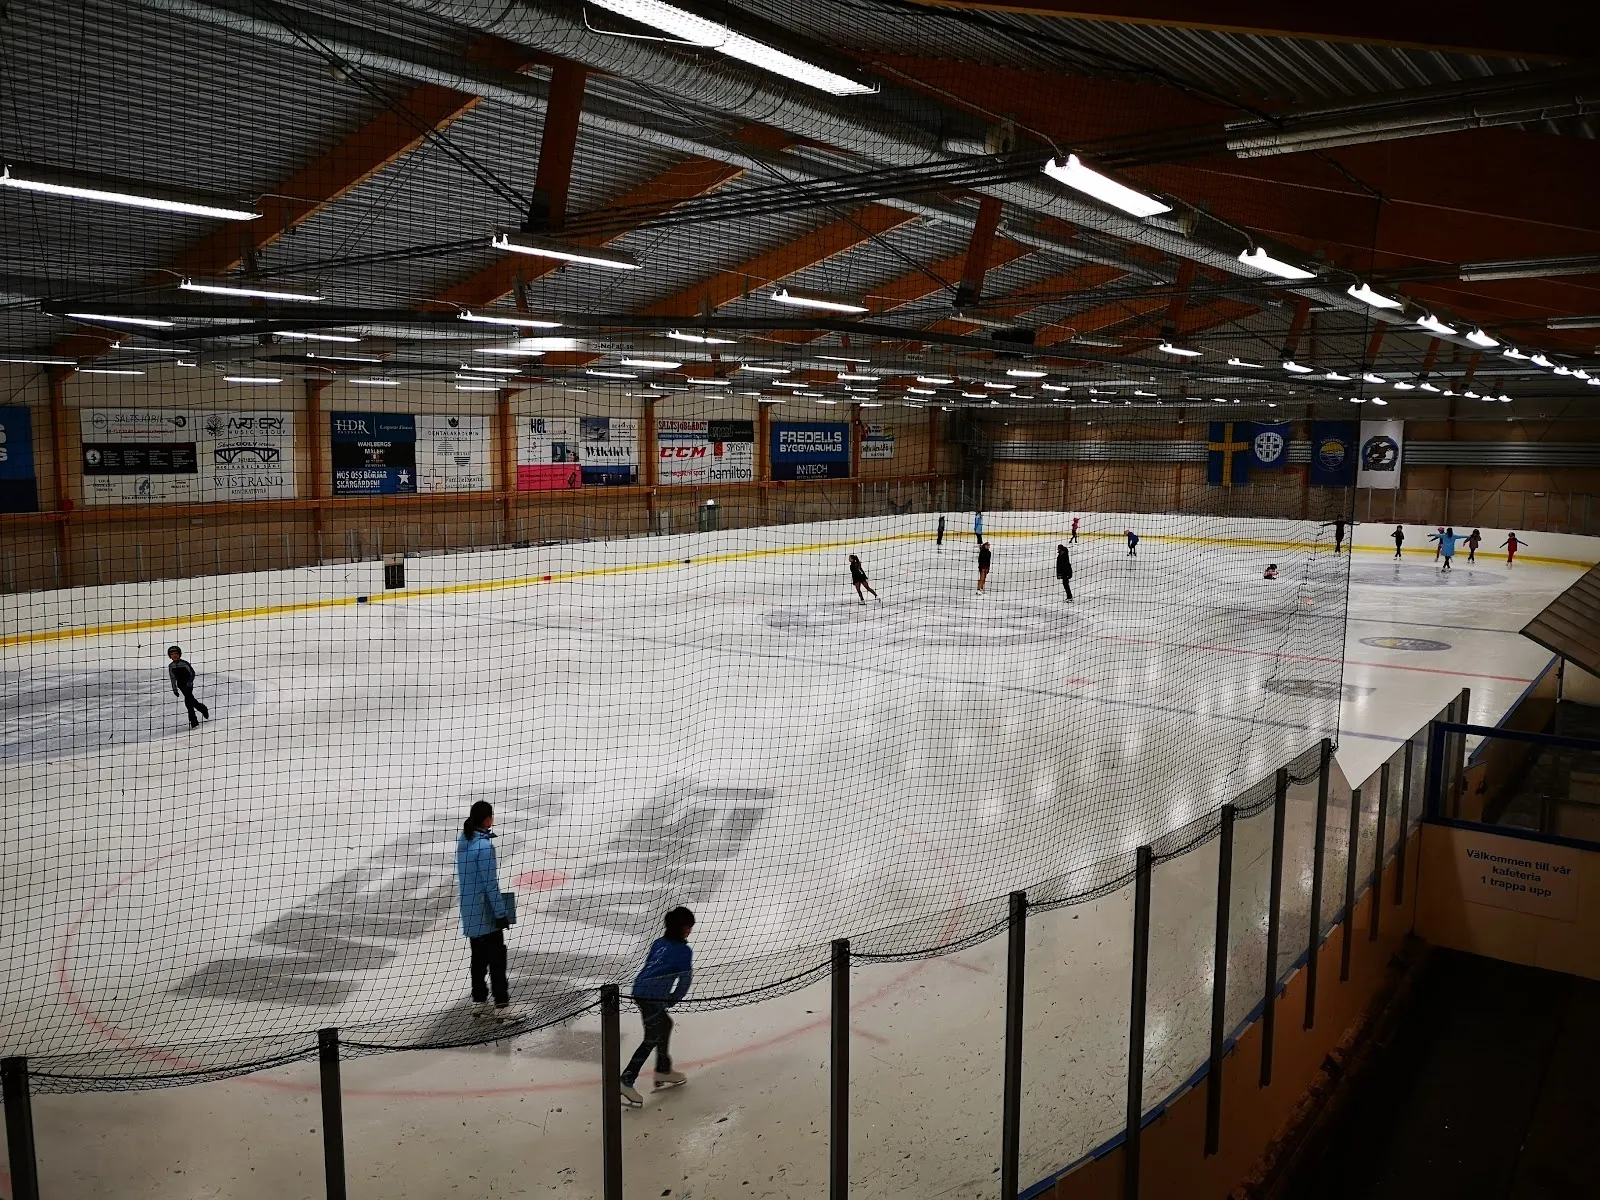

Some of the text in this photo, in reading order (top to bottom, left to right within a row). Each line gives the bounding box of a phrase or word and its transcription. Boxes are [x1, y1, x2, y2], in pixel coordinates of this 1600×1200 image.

[333, 419, 371, 435] HDR
[779, 431, 842, 443] FREDELLS
[659, 446, 708, 458] CCM
[779, 444, 842, 453] BYGGVARUHUS
[350, 470, 363, 479] OSS
[709, 465, 752, 480] hamilton
[213, 476, 284, 487] WISTRAND
[1466, 848, 1572, 876] Välkommen till vår
[1492, 865, 1542, 883] kafeteria
[1481, 875, 1552, 898] 1 trappa upp
